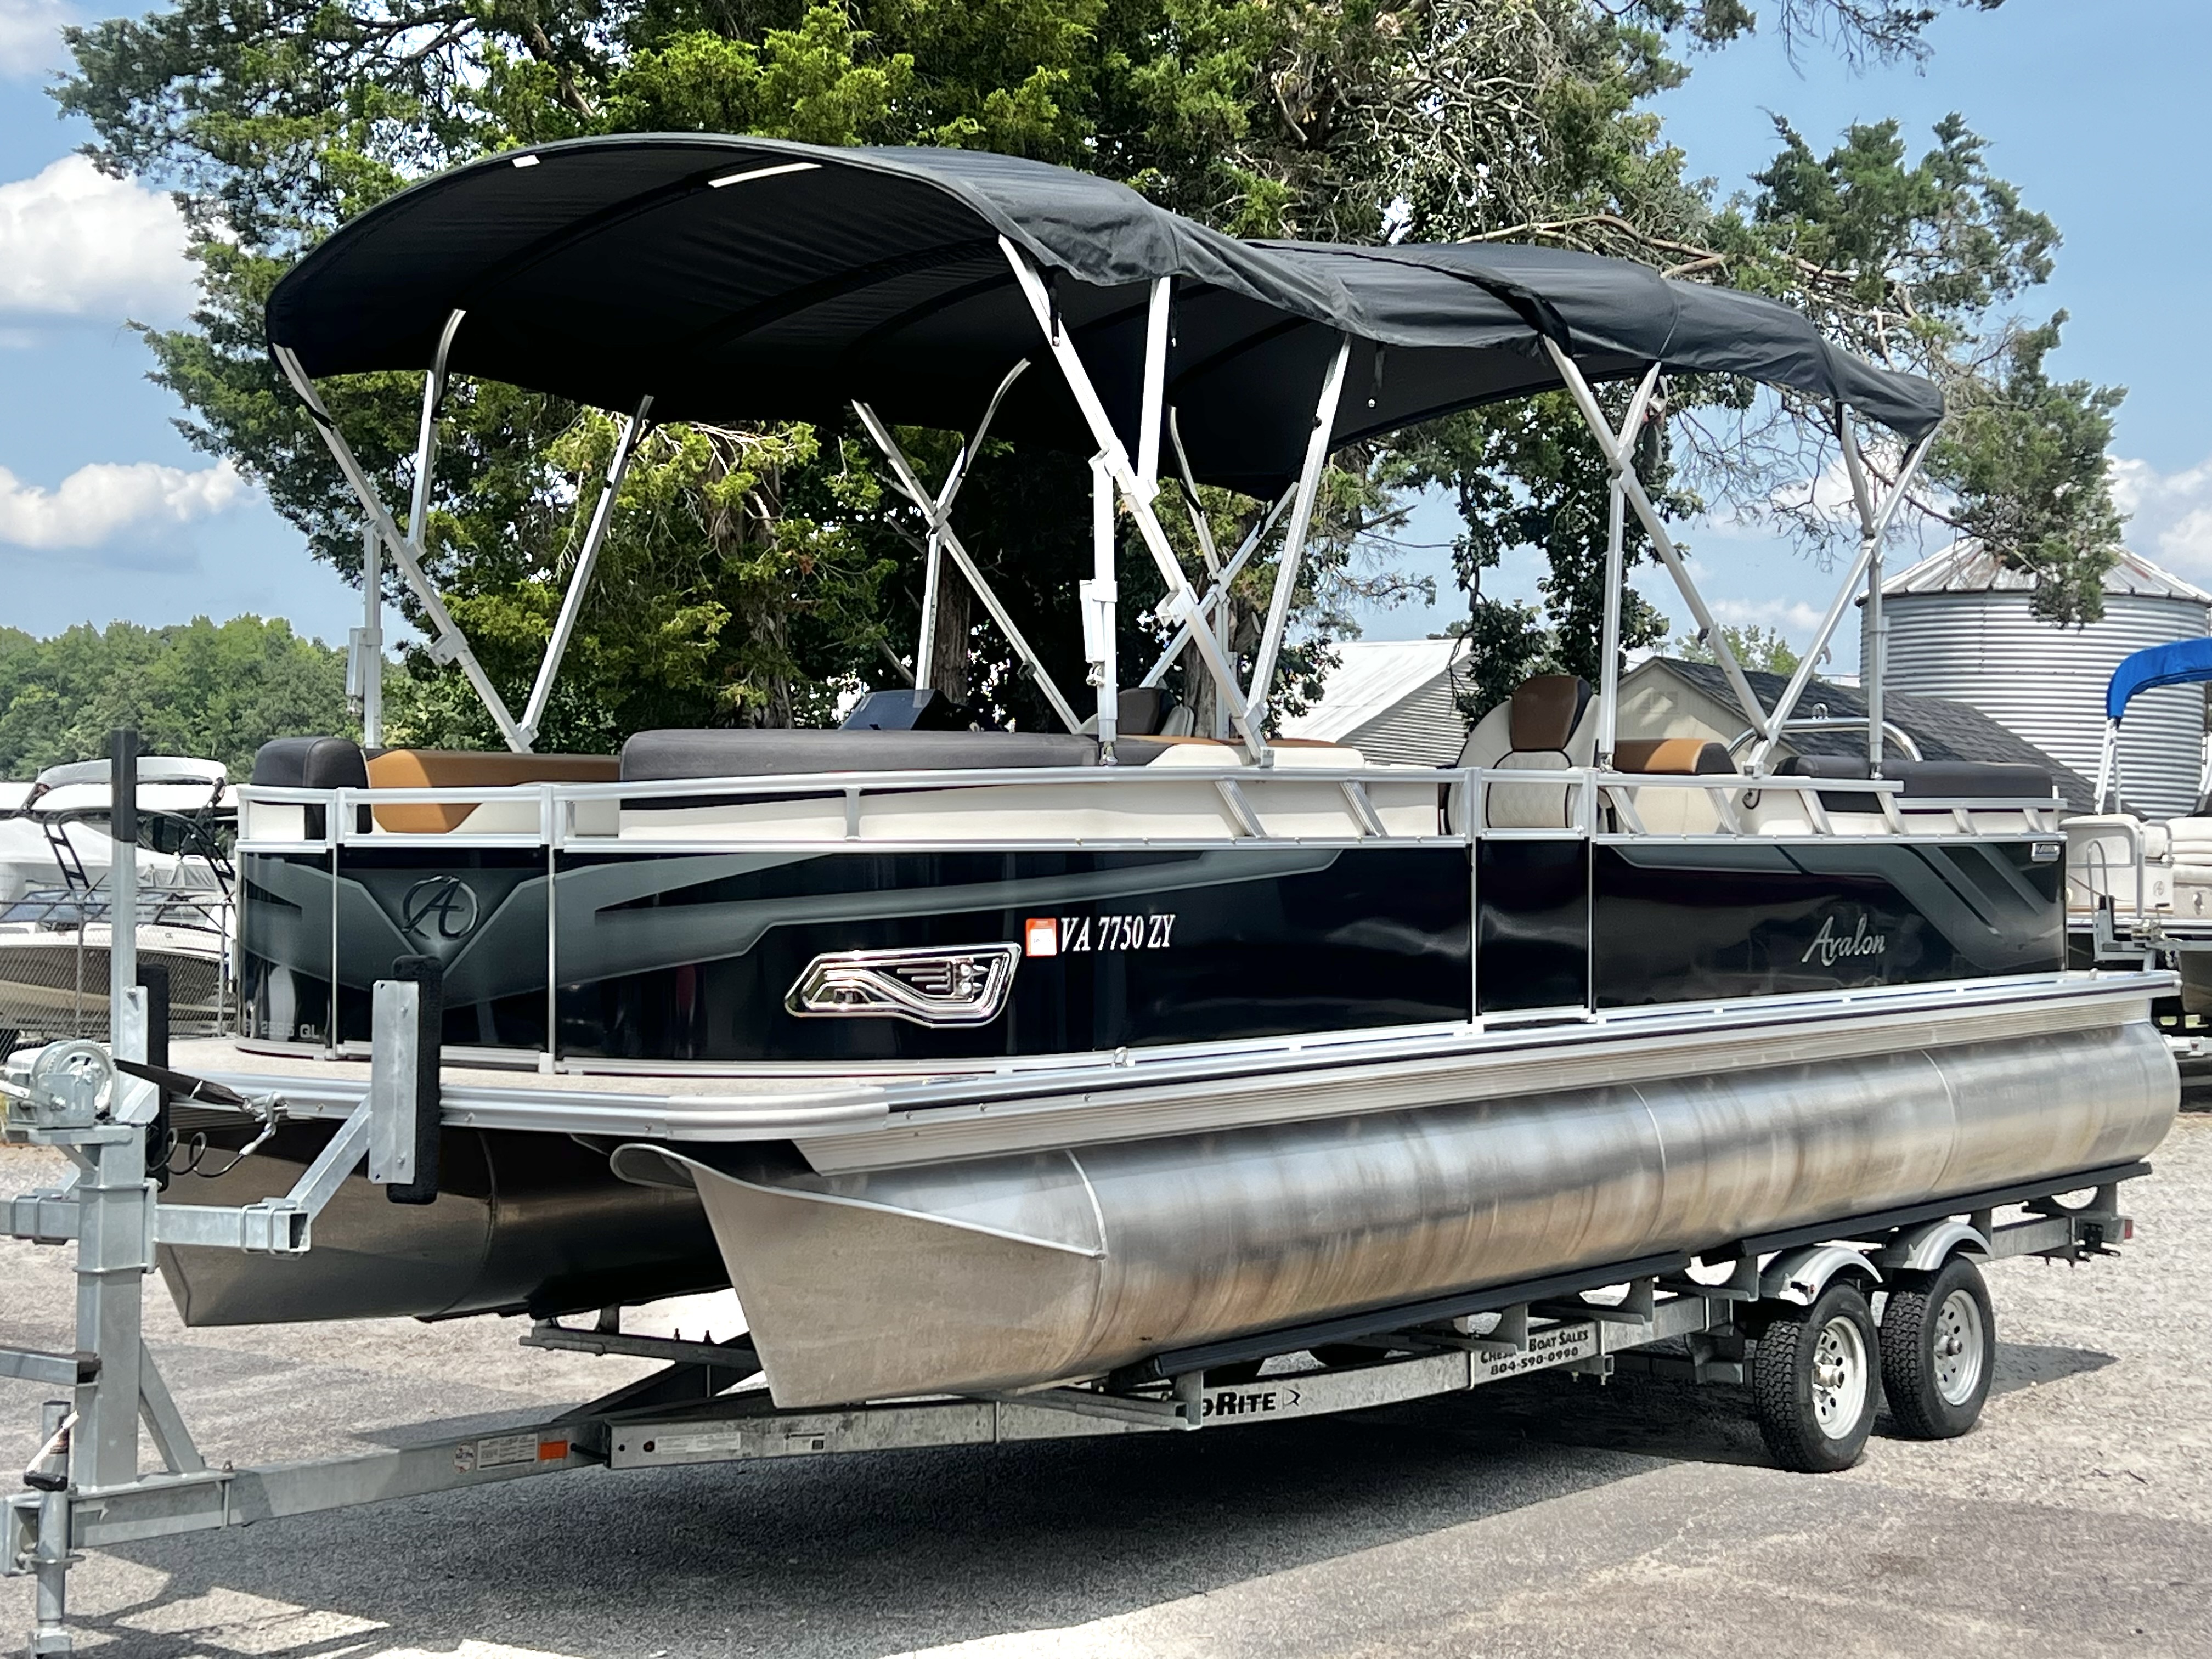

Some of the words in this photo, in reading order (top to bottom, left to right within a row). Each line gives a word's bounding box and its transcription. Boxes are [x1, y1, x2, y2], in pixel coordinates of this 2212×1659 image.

[1061, 917, 1091, 952] VA
[1098, 915, 1144, 951] 7750
[1147, 914, 1176, 948] ZY
[1801, 913, 1886, 966] Avalon
[300, 1023, 320, 1040] QL
[1528, 1336, 1557, 1352] BOAT
[1559, 1330, 1589, 1346] SALES
[1490, 1346, 1578, 1376] 804-590-0990
